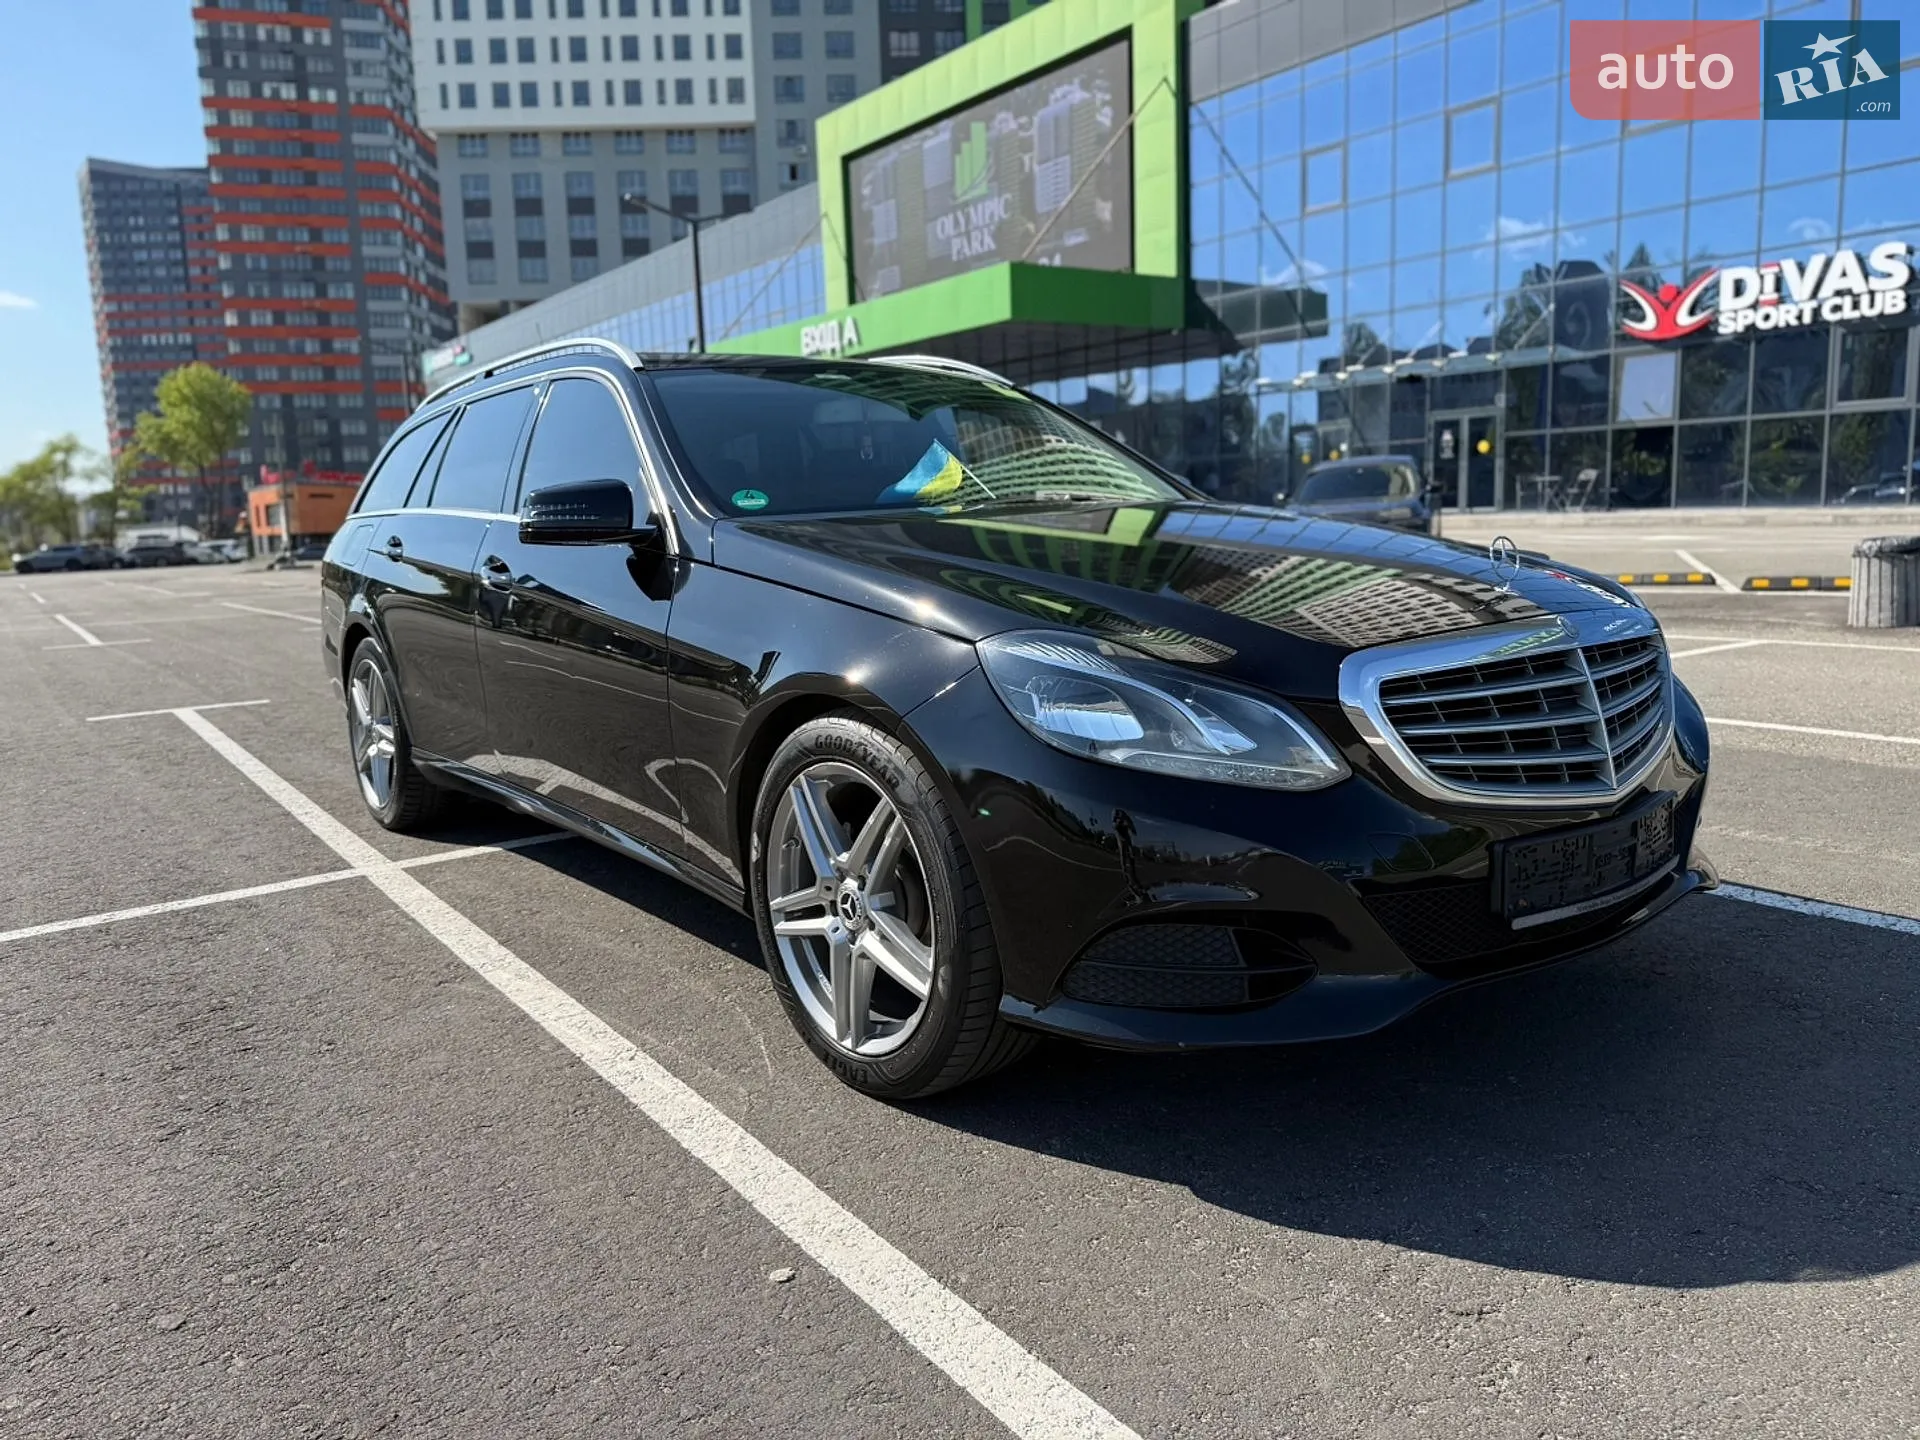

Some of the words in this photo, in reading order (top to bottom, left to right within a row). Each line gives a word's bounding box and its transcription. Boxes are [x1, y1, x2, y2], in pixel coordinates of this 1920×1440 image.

[936, 193, 1012, 240] OLYMPIC
[951, 222, 996, 262] PARK
[1717, 300, 1818, 335] SPORT
[1821, 289, 1907, 322] CLUB
[815, 734, 900, 790] GOODYEAR
